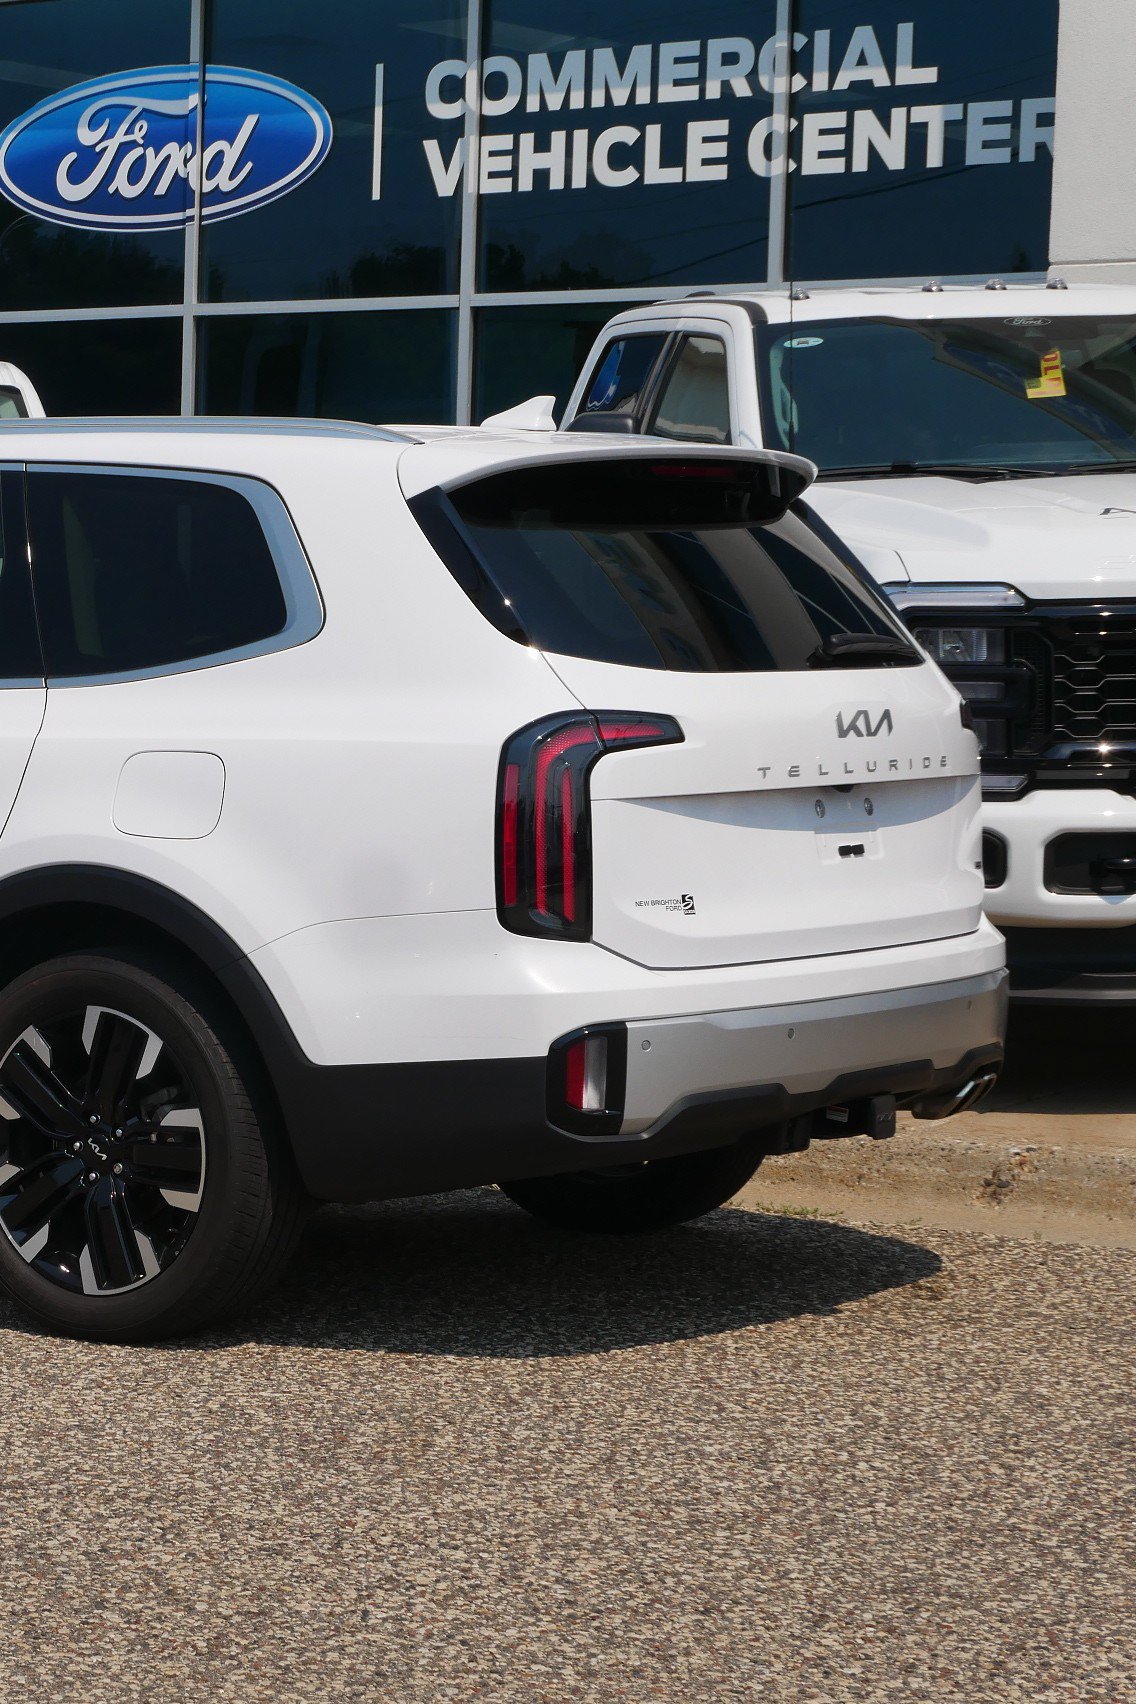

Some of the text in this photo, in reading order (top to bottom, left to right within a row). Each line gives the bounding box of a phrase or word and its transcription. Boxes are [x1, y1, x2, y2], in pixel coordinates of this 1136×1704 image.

[424, 22, 939, 119] COMMERCIAL
[55, 95, 260, 202] Ford
[422, 96, 1056, 198] VEHICLE CENTER
[757, 755, 948, 780] TELLURIDE
[835, 708, 894, 739] KIA
